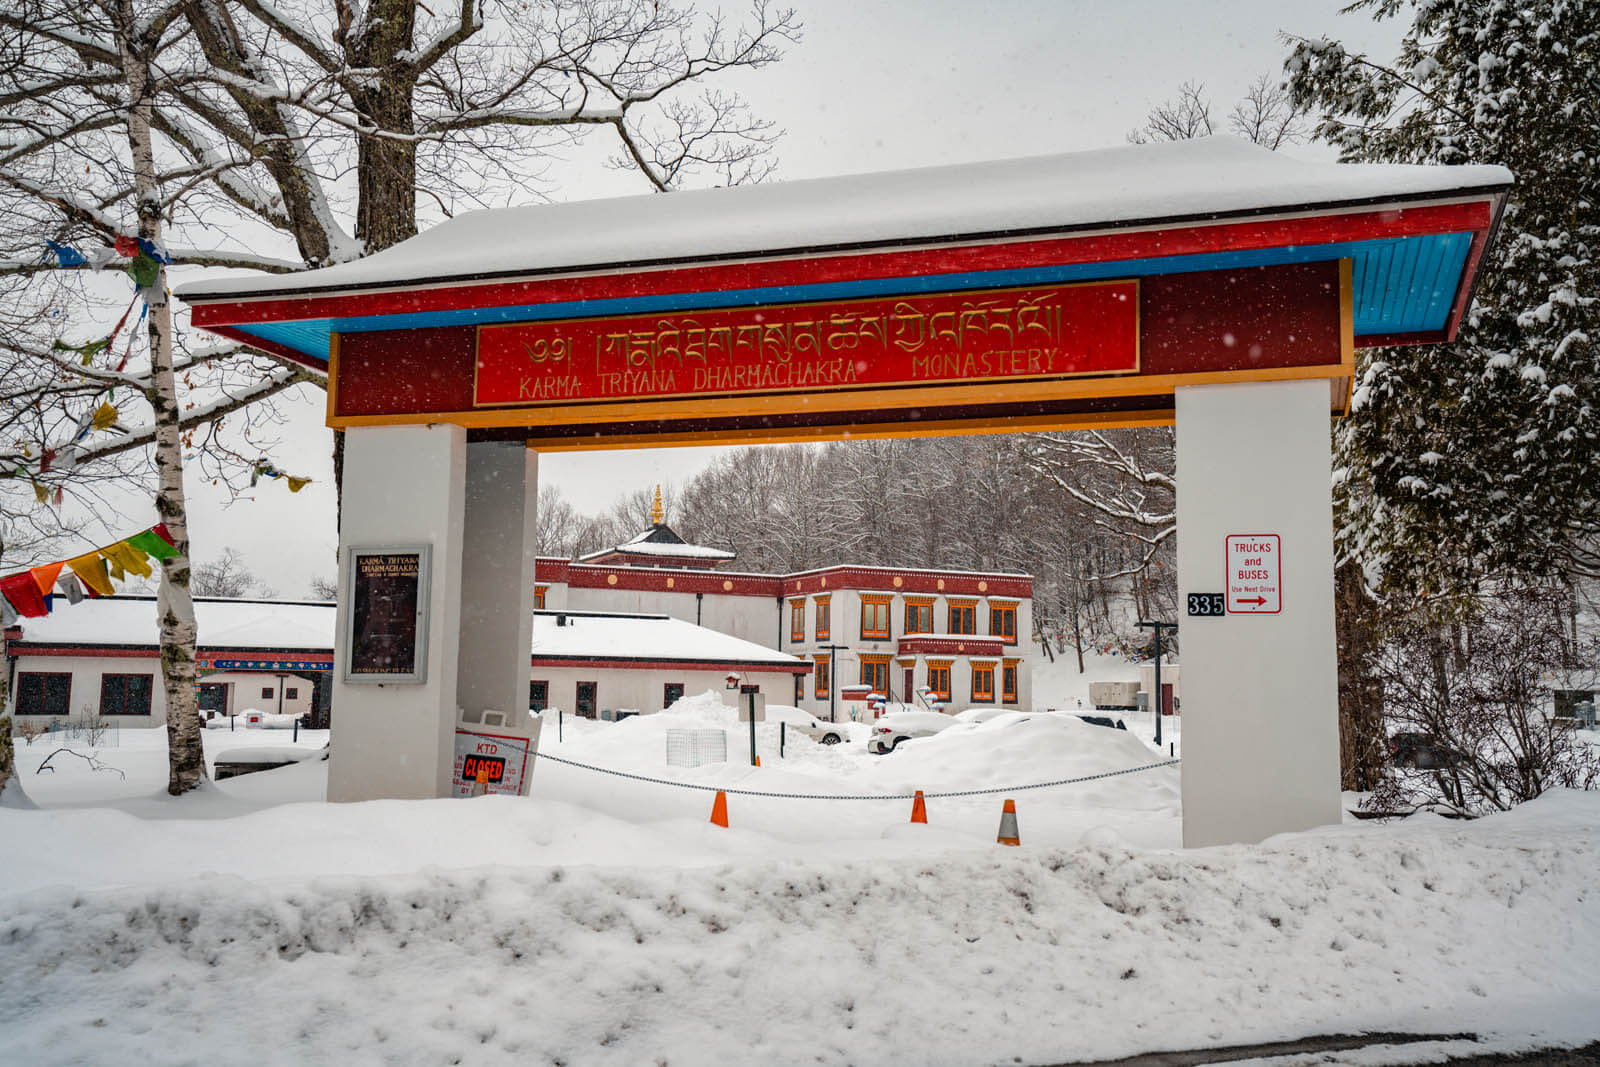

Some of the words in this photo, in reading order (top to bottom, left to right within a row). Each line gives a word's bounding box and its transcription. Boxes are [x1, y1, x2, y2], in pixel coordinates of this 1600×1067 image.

[519, 375, 581, 399] KARMA
[599, 368, 677, 394] TRIYANA
[693, 359, 857, 390] DHARMACHAKRA
[912, 347, 1059, 378] MONASTERY
[1234, 543, 1272, 553] TRUCKS
[1244, 556, 1262, 566] and
[1238, 570, 1269, 580] BUSES
[1188, 596, 1224, 614] 335
[476, 743, 498, 755] KTD
[465, 758, 503, 778] CLOSED
